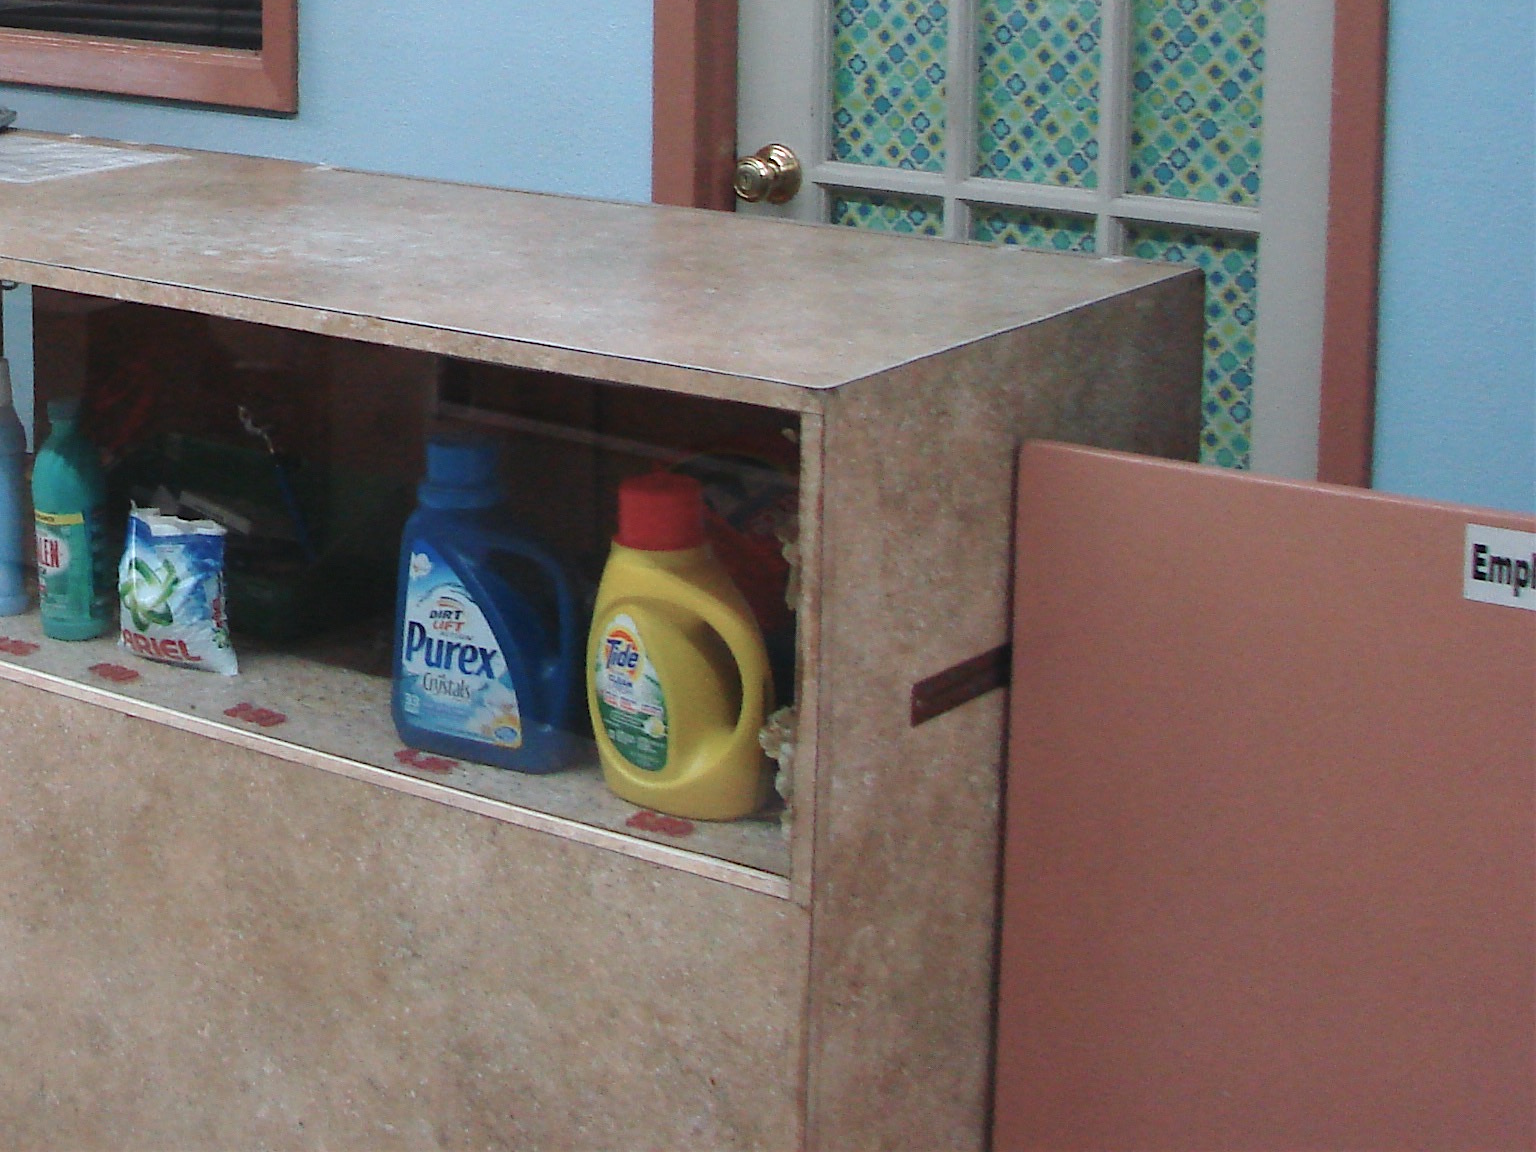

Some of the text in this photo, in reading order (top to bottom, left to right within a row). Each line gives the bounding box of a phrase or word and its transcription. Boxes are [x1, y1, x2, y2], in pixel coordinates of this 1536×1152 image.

[430, 610, 463, 620] DIRT
[432, 621, 465, 632] LIFT
[122, 629, 201, 662] ARIEL
[406, 621, 497, 679] Purex
[606, 639, 639, 668] Tide
[424, 673, 470, 698] Crystals
